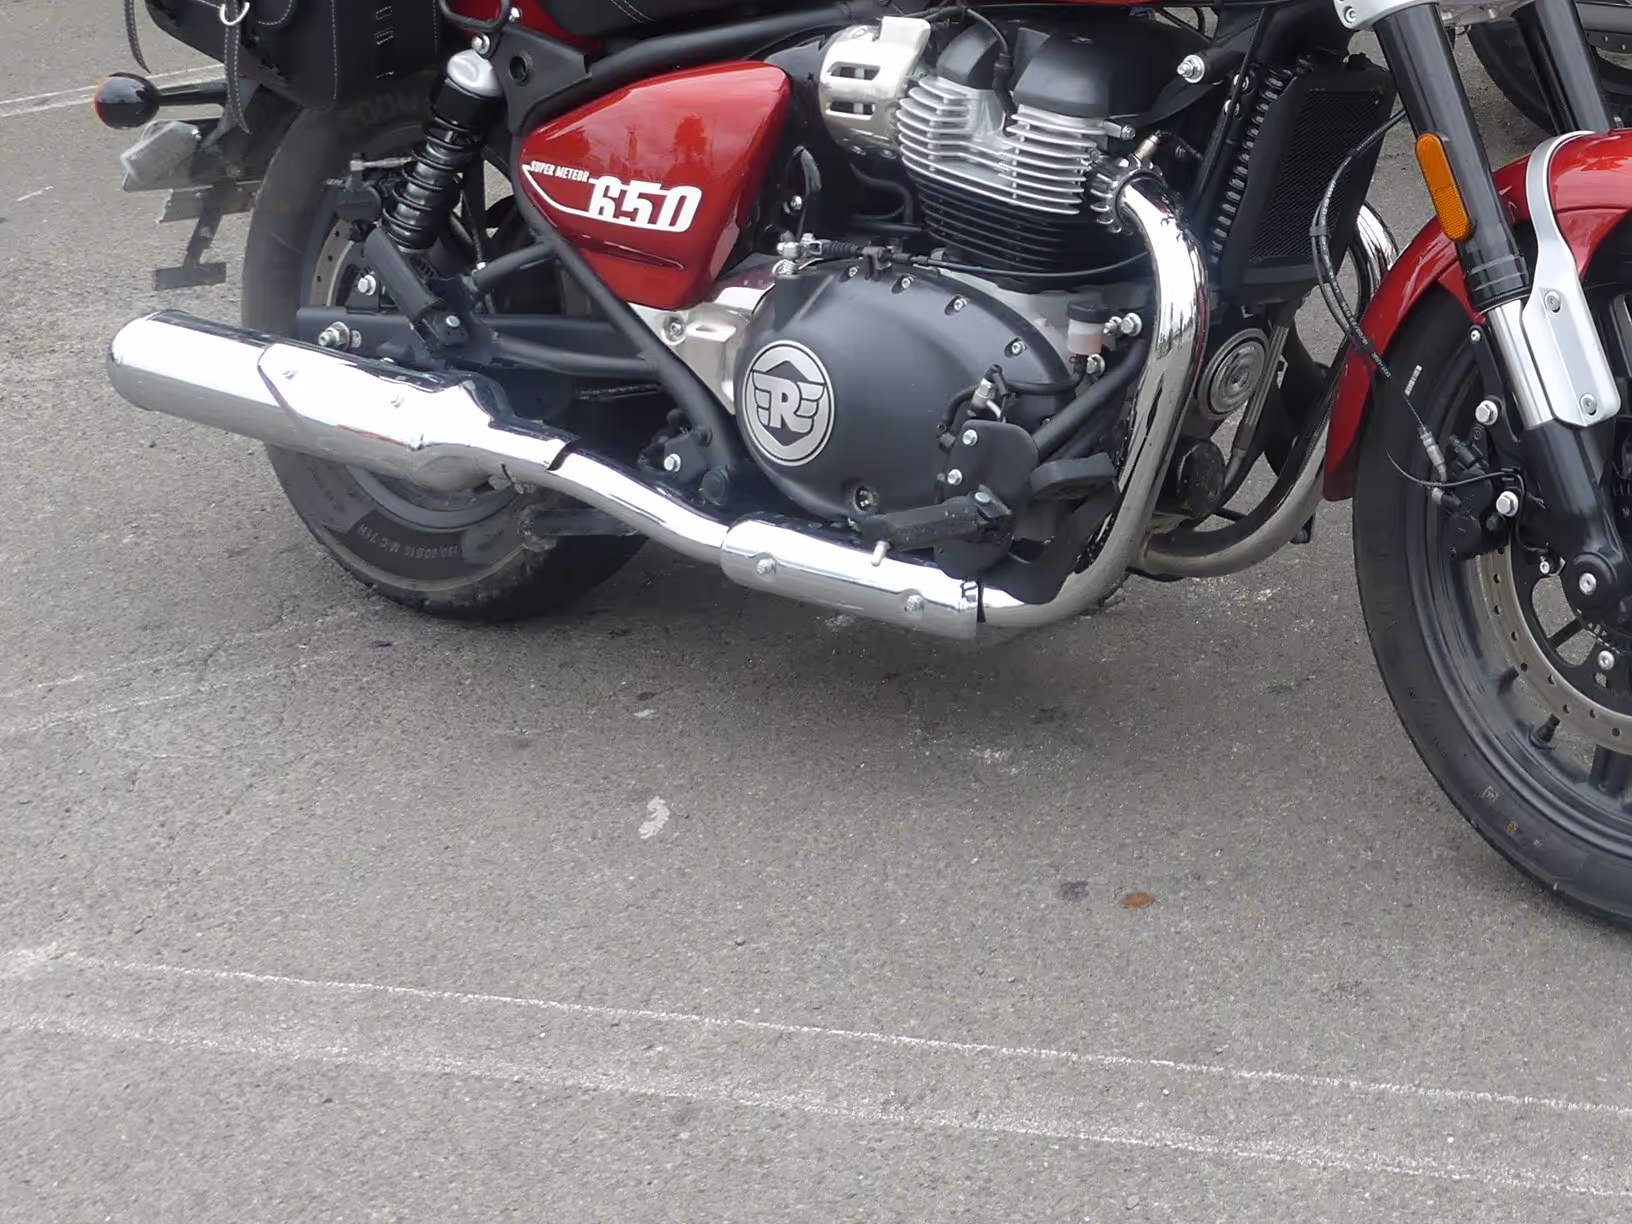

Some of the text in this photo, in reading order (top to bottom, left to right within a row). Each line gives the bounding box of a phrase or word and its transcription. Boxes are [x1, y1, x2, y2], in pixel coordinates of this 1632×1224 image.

[530, 160, 589, 183] SUPER METEOR
[588, 176, 702, 233] 650
